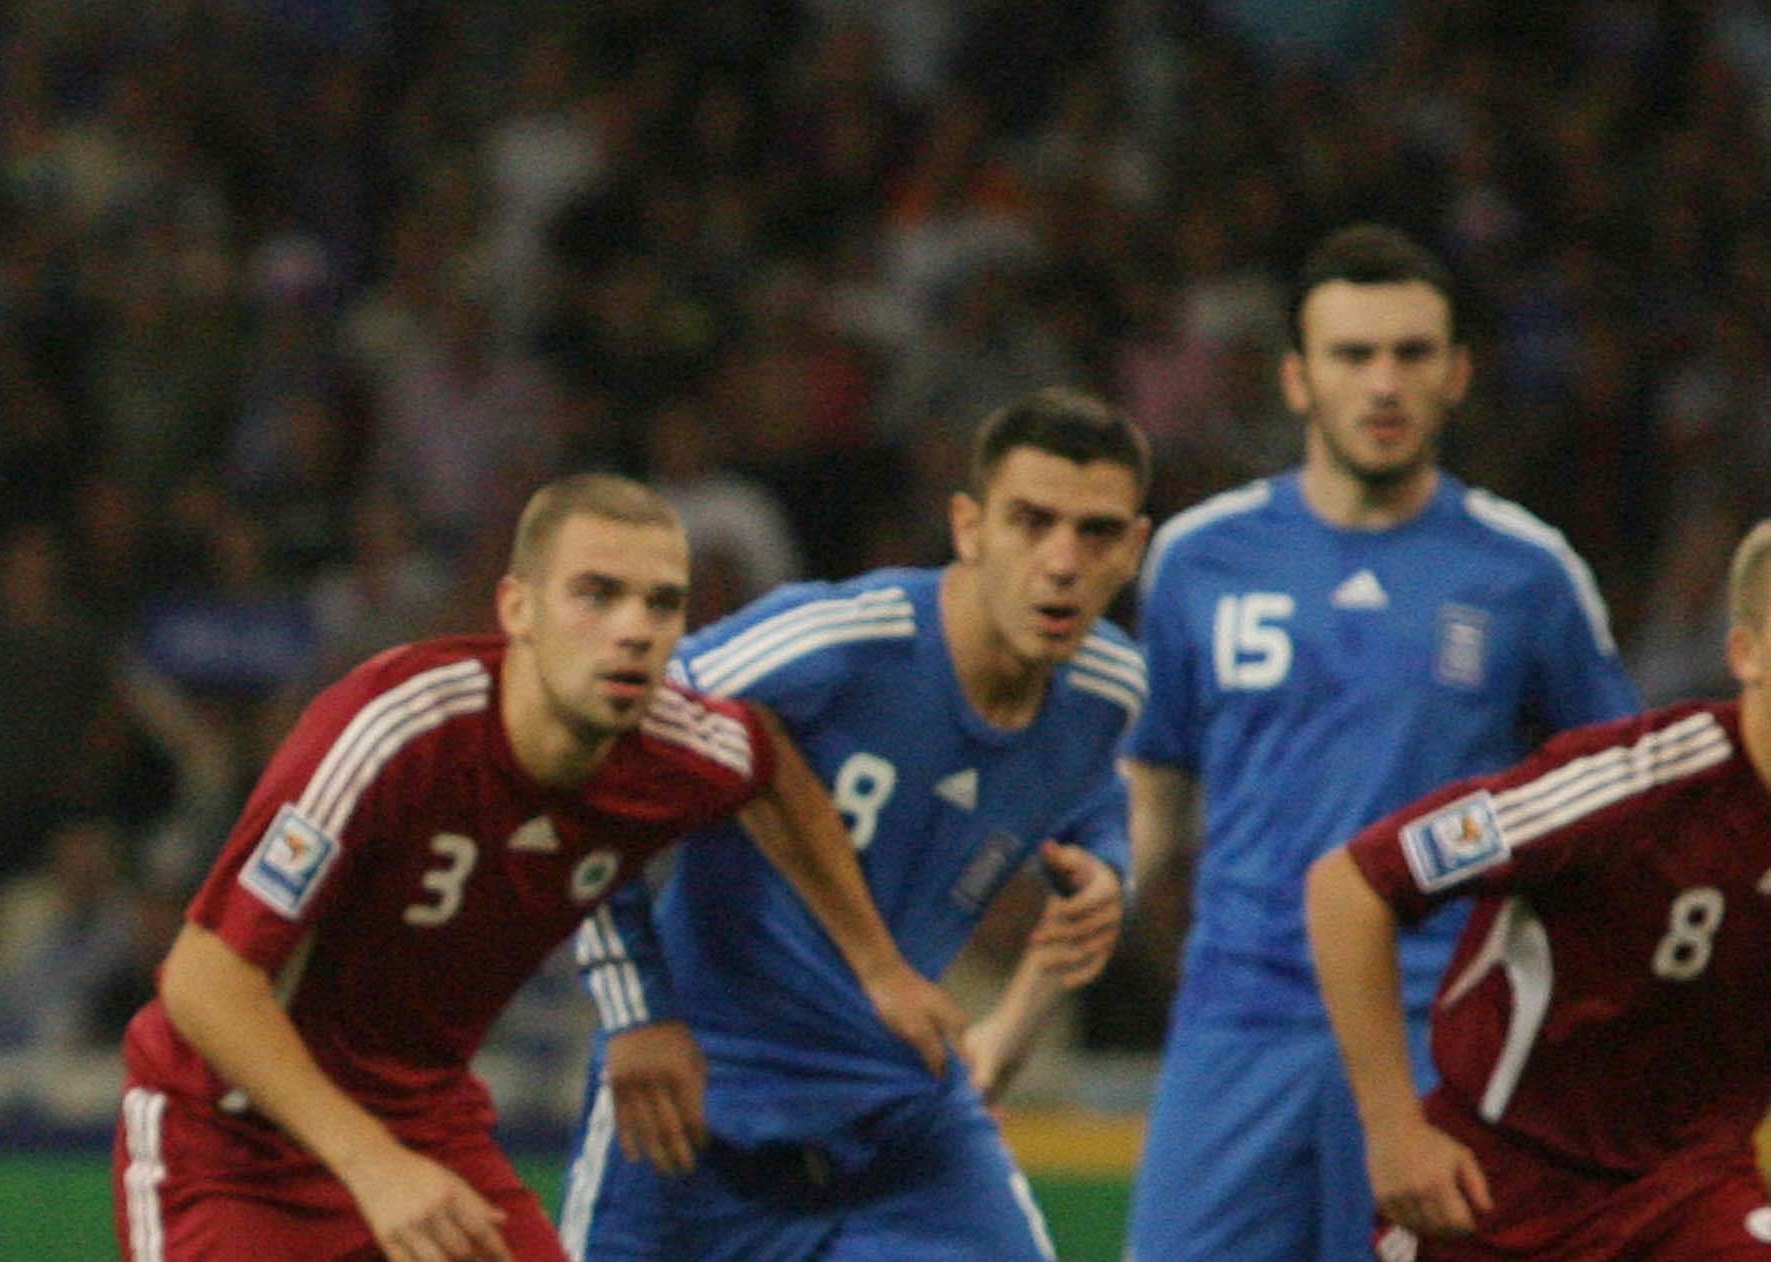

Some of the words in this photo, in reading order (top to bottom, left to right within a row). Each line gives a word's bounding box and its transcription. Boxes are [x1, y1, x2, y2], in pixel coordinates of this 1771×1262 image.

[1213, 591, 1294, 691] 15
[834, 752, 896, 850] 8
[403, 832, 478, 928] 3
[1651, 886, 1726, 980] 8
